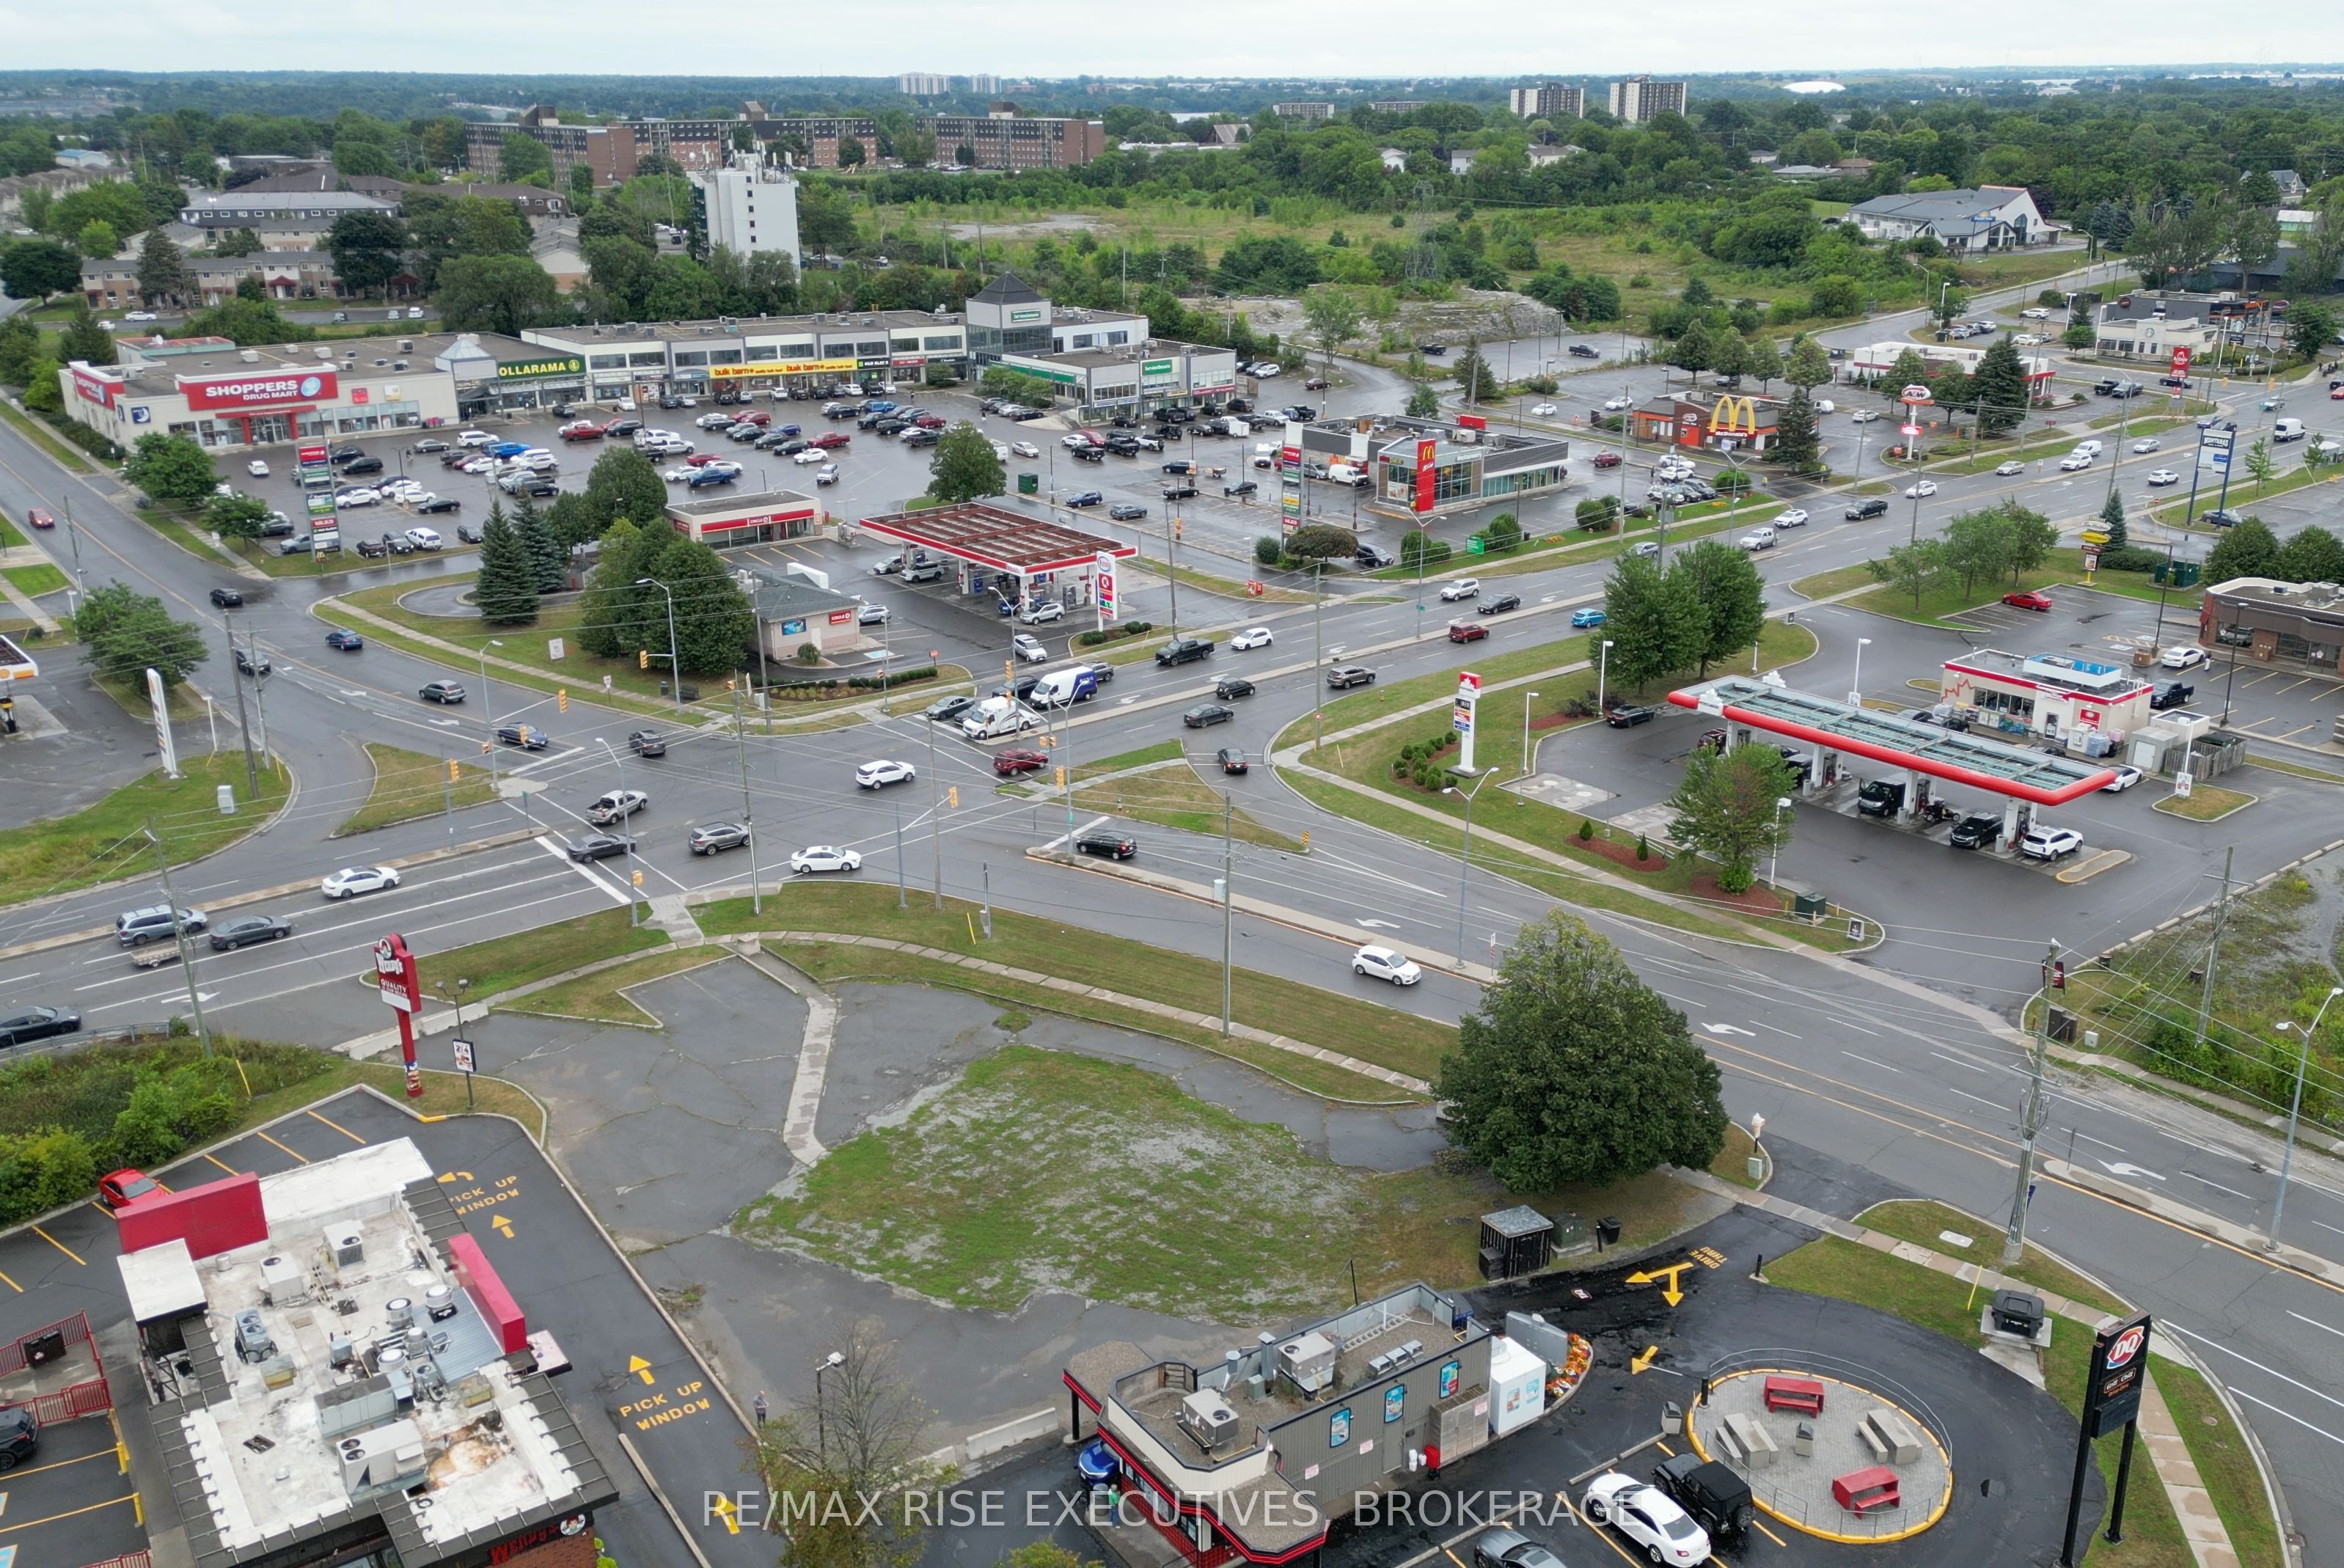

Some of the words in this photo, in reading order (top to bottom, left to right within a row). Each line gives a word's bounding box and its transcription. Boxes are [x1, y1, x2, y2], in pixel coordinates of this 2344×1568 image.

[499, 362, 565, 376] OLLARAMA
[205, 380, 298, 397] SHOPPERS
[243, 392, 270, 400] DRUG
[381, 979, 406, 993] QUALITY
[495, 1176, 516, 1187] UP
[455, 1189, 519, 1215] WINDOW
[1688, 1250, 1721, 1269] DRIVE
[1700, 1247, 1727, 1264] THRU
[2114, 1333, 2139, 1360] DQ
[620, 1393, 668, 1417] PICK
[677, 1382, 702, 1396] UP
[636, 1399, 710, 1430] WINDOW
